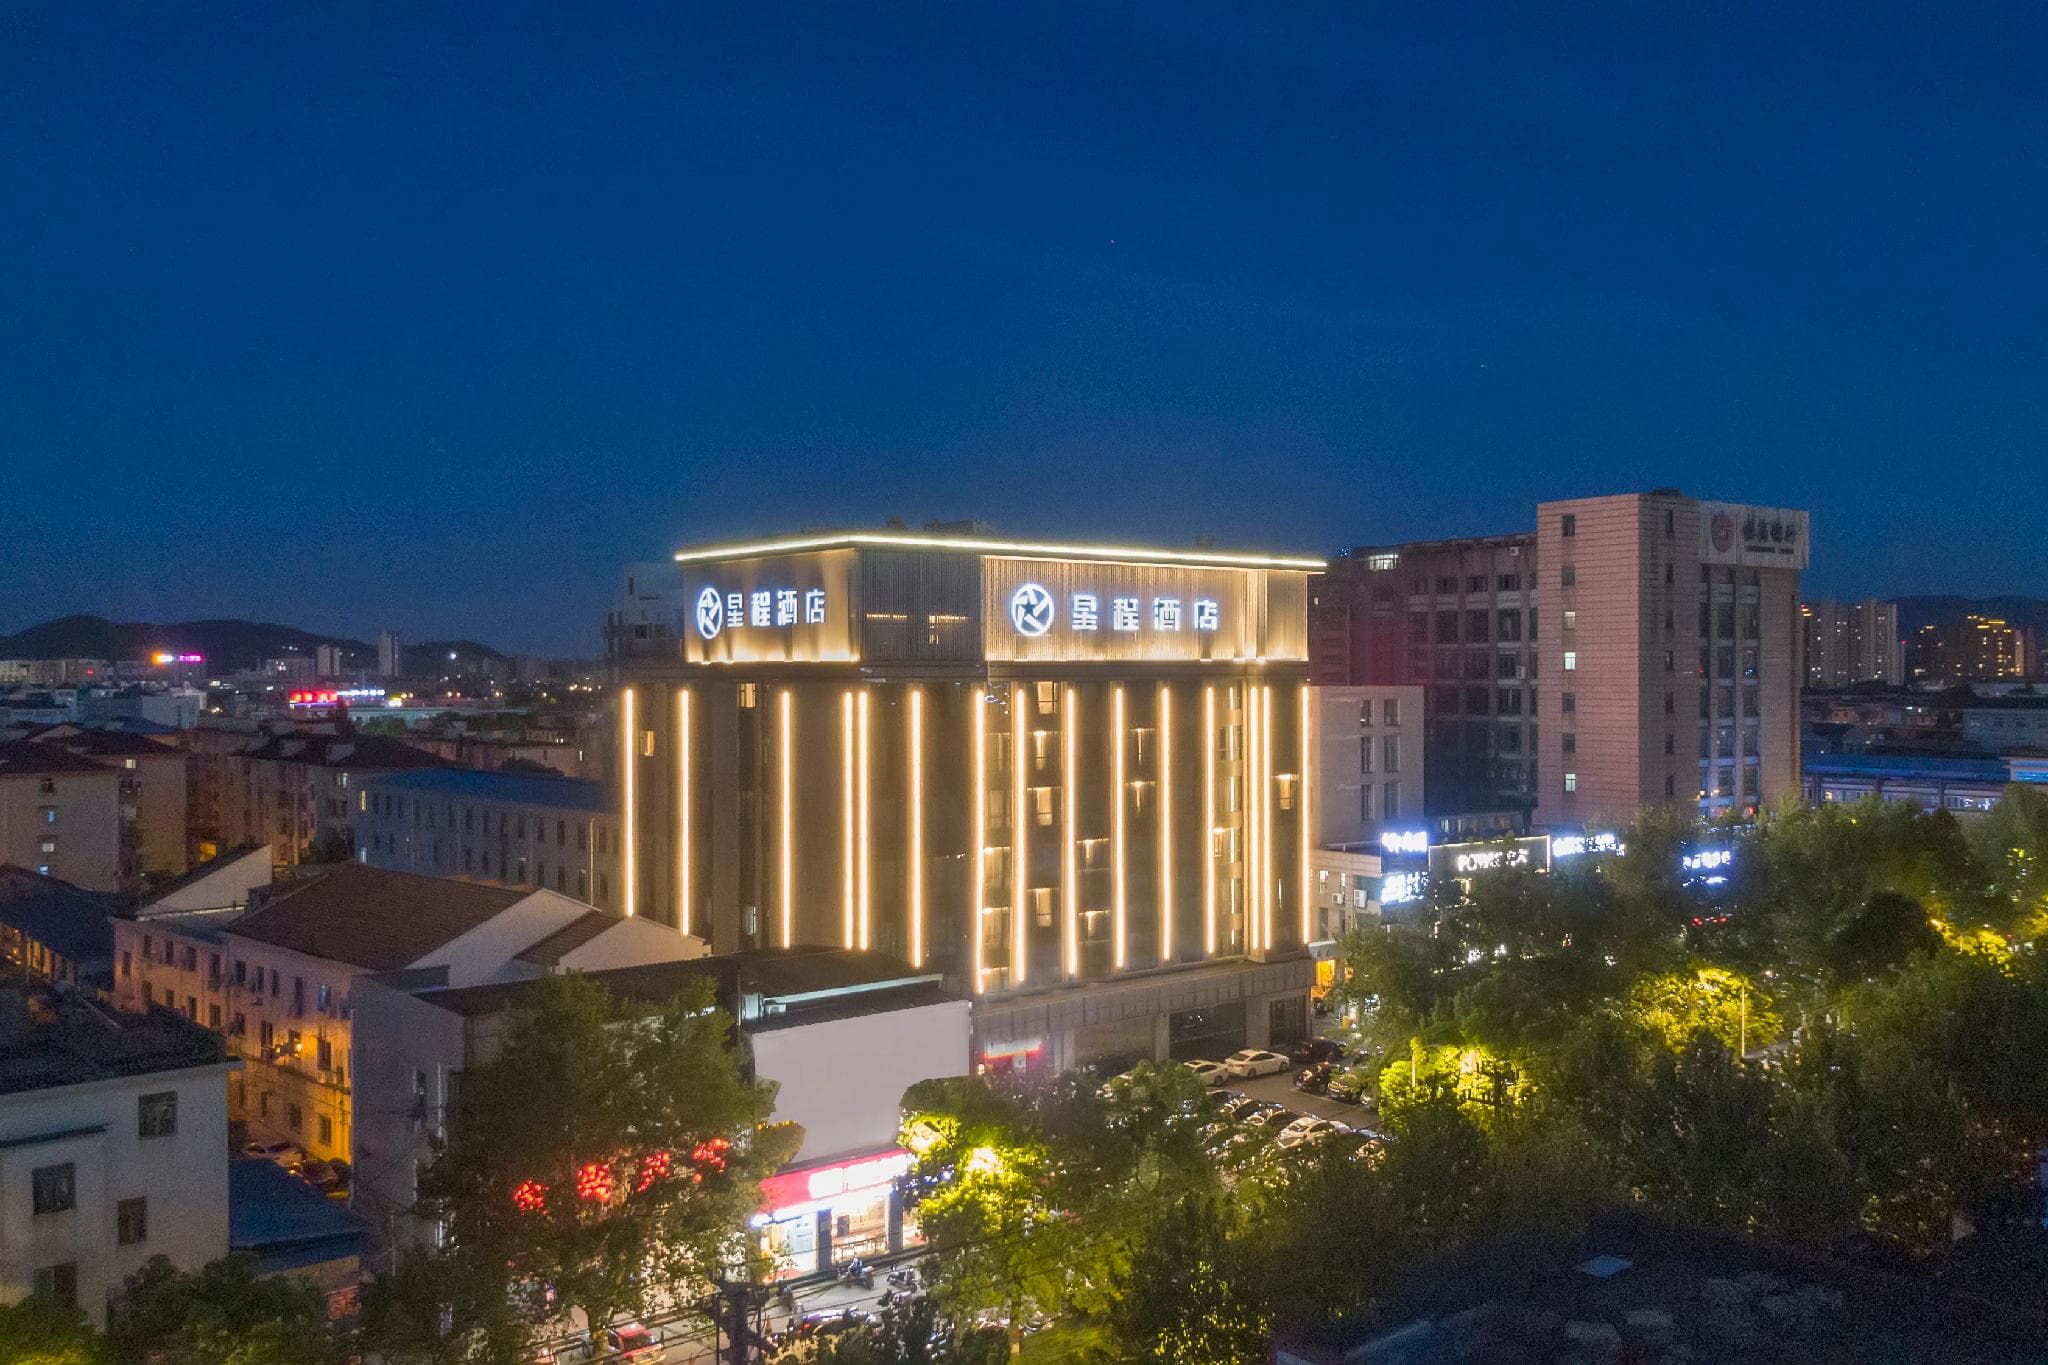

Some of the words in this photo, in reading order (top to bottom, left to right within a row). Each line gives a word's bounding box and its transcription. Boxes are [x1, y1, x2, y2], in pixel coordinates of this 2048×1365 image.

[727, 588, 826, 627] 星程酒店
[1071, 594, 1218, 632] 星程酒店
